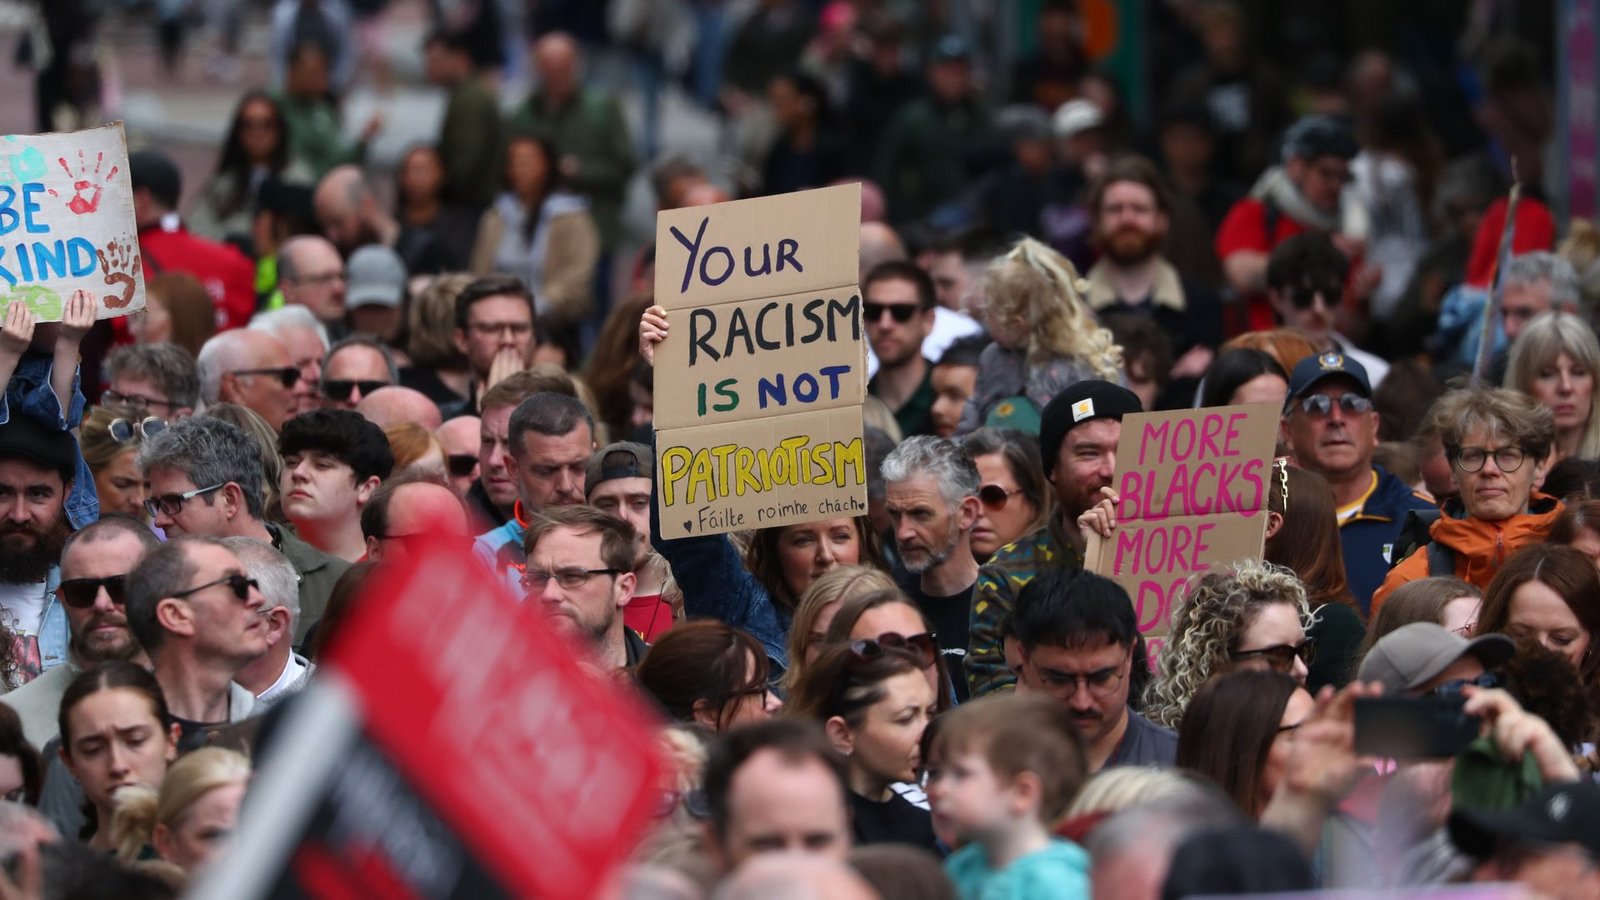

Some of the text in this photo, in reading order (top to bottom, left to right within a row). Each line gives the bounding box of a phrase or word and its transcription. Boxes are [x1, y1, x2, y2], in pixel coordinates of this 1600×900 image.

[0, 183, 50, 236] BE
[689, 294, 861, 367] RACISM
[697, 365, 851, 417] IS NOT
[1138, 413, 1248, 465] MORE
[661, 435, 865, 507] PATRIOTISM
[1118, 458, 1264, 523] BLACKS
[698, 496, 858, 532] Fáilte roimhe chách
[1114, 523, 1215, 576] MORE
